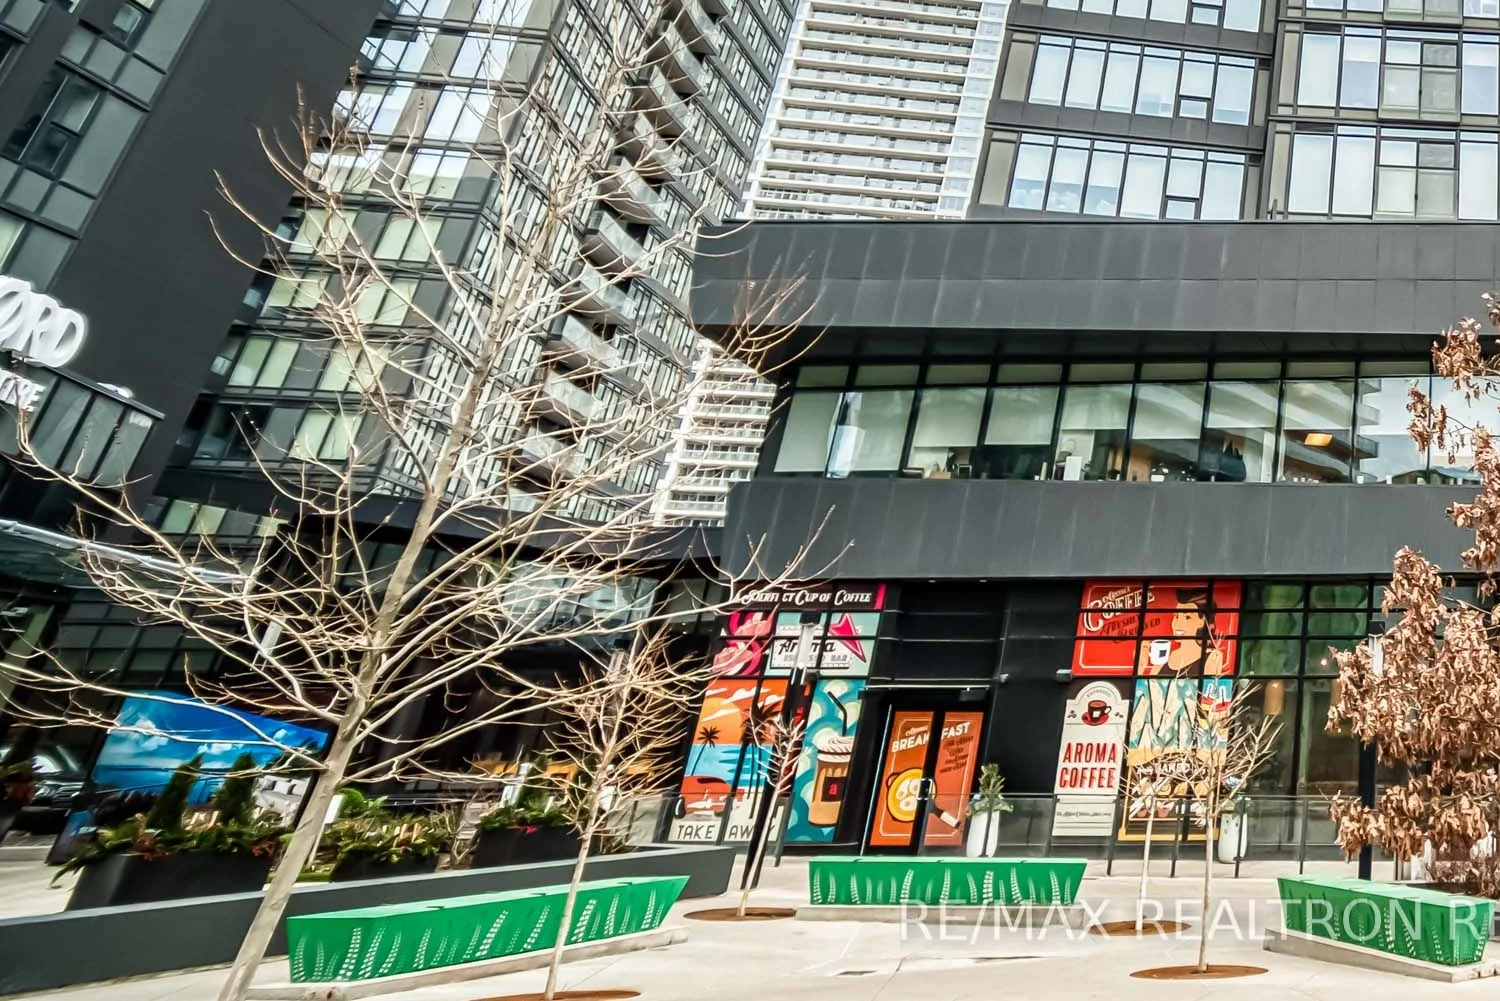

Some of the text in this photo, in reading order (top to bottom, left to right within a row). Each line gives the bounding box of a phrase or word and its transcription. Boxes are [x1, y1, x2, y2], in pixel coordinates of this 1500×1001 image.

[1062, 741, 1118, 764] AROMA
[1058, 766, 1117, 789] COFFEE
[677, 824, 716, 840] TAKE
